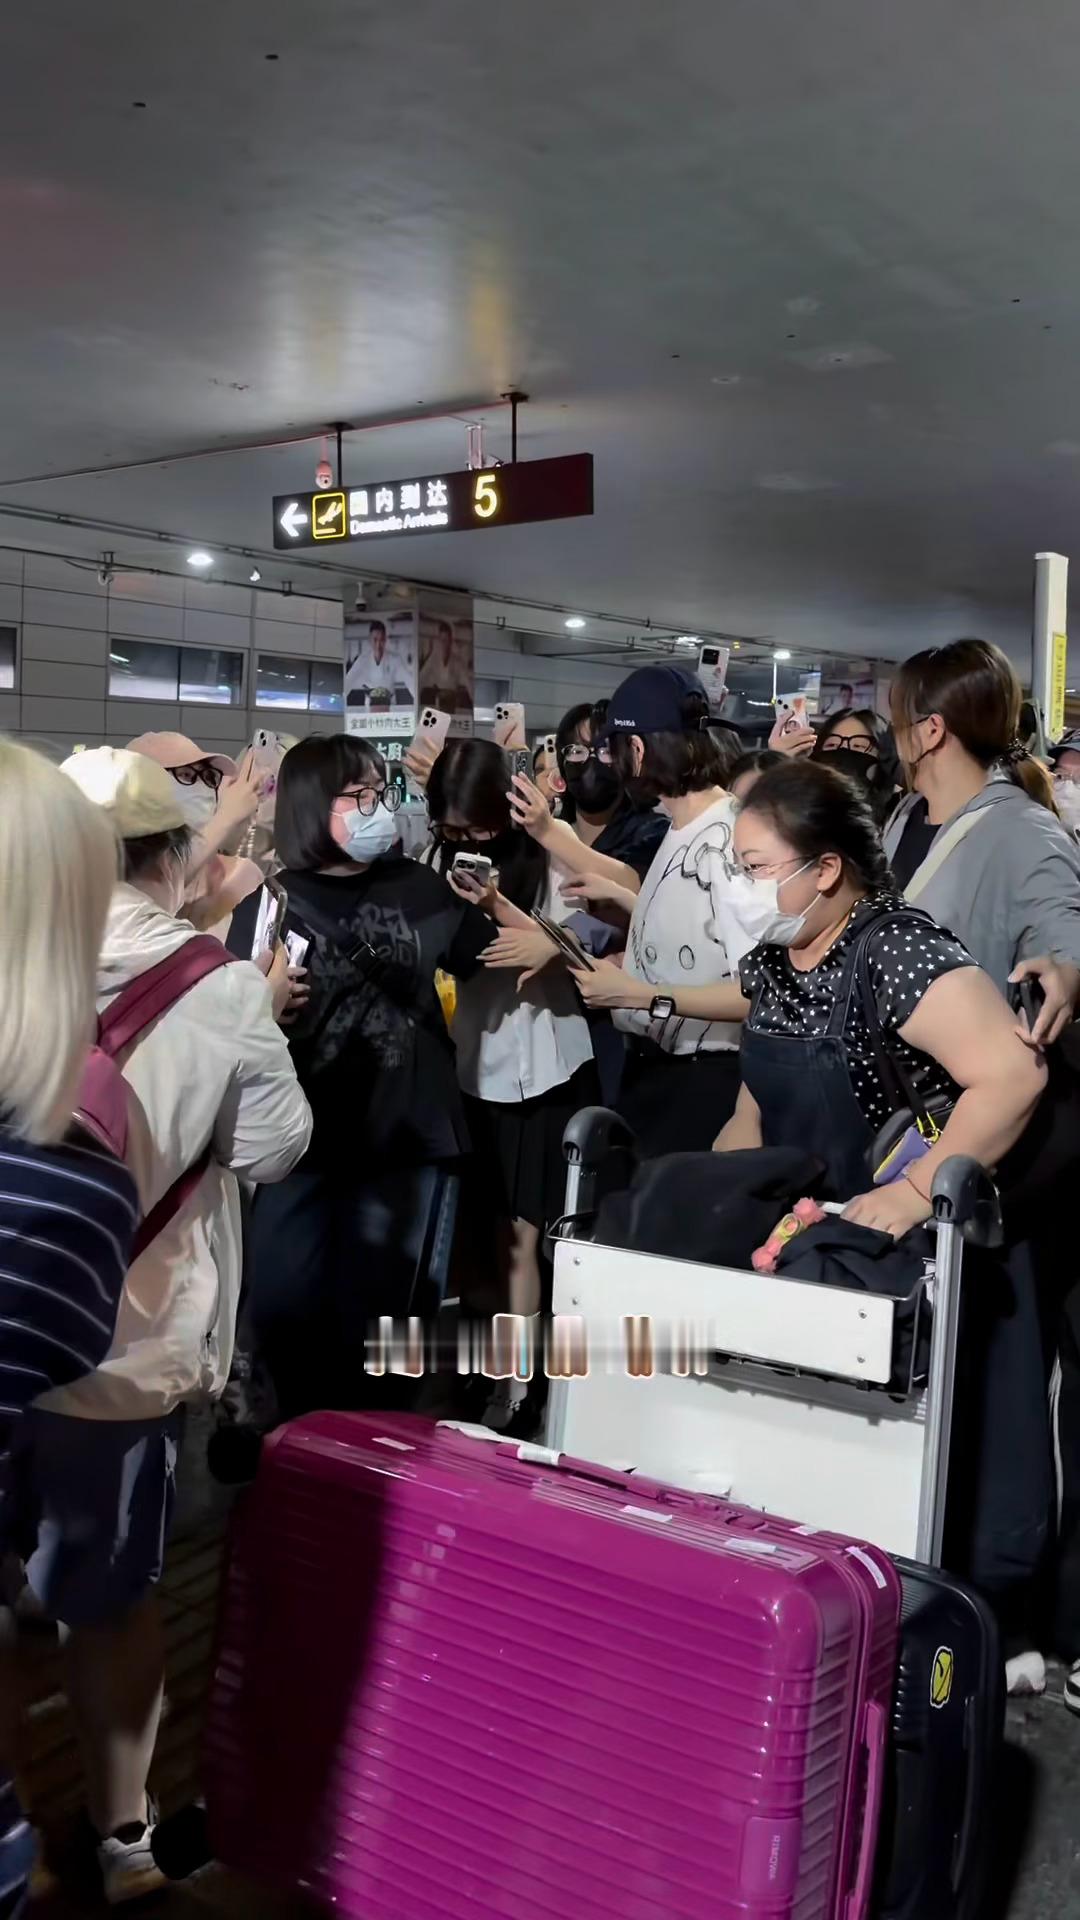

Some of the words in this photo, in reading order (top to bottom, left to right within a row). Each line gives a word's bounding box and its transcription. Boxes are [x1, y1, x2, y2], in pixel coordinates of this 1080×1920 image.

[350, 480, 448, 516] 国内到达
[474, 474, 497, 518] 5
[350, 516, 402, 535] Domestic
[403, 511, 449, 529] Arrivals
